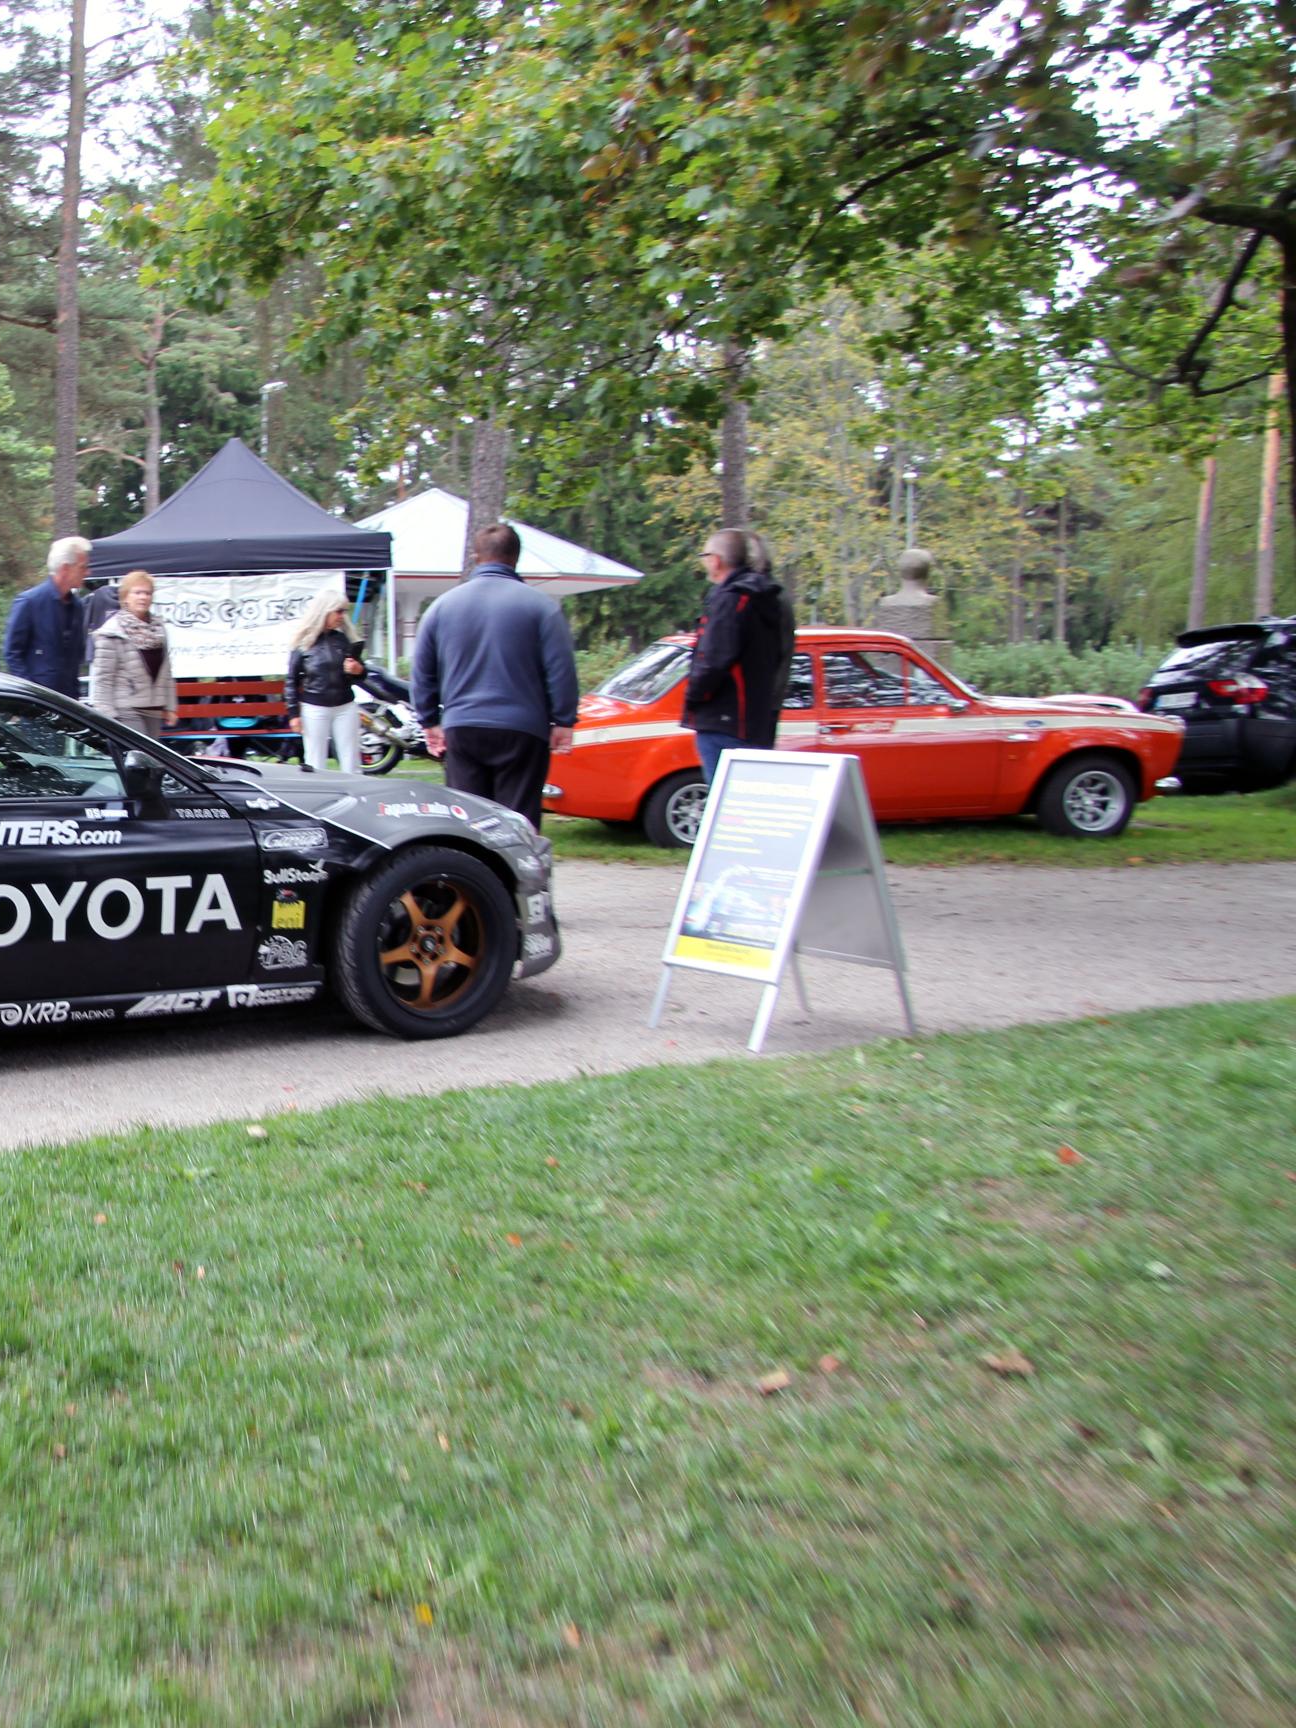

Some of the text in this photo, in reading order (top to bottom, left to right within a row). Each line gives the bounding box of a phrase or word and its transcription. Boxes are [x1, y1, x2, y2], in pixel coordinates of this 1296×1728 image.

[154, 595, 314, 628] RLS GO FA
[175, 808, 230, 819] TAKATA
[22, 1001, 70, 1024] KRB
[70, 1008, 115, 1020] TRADING
